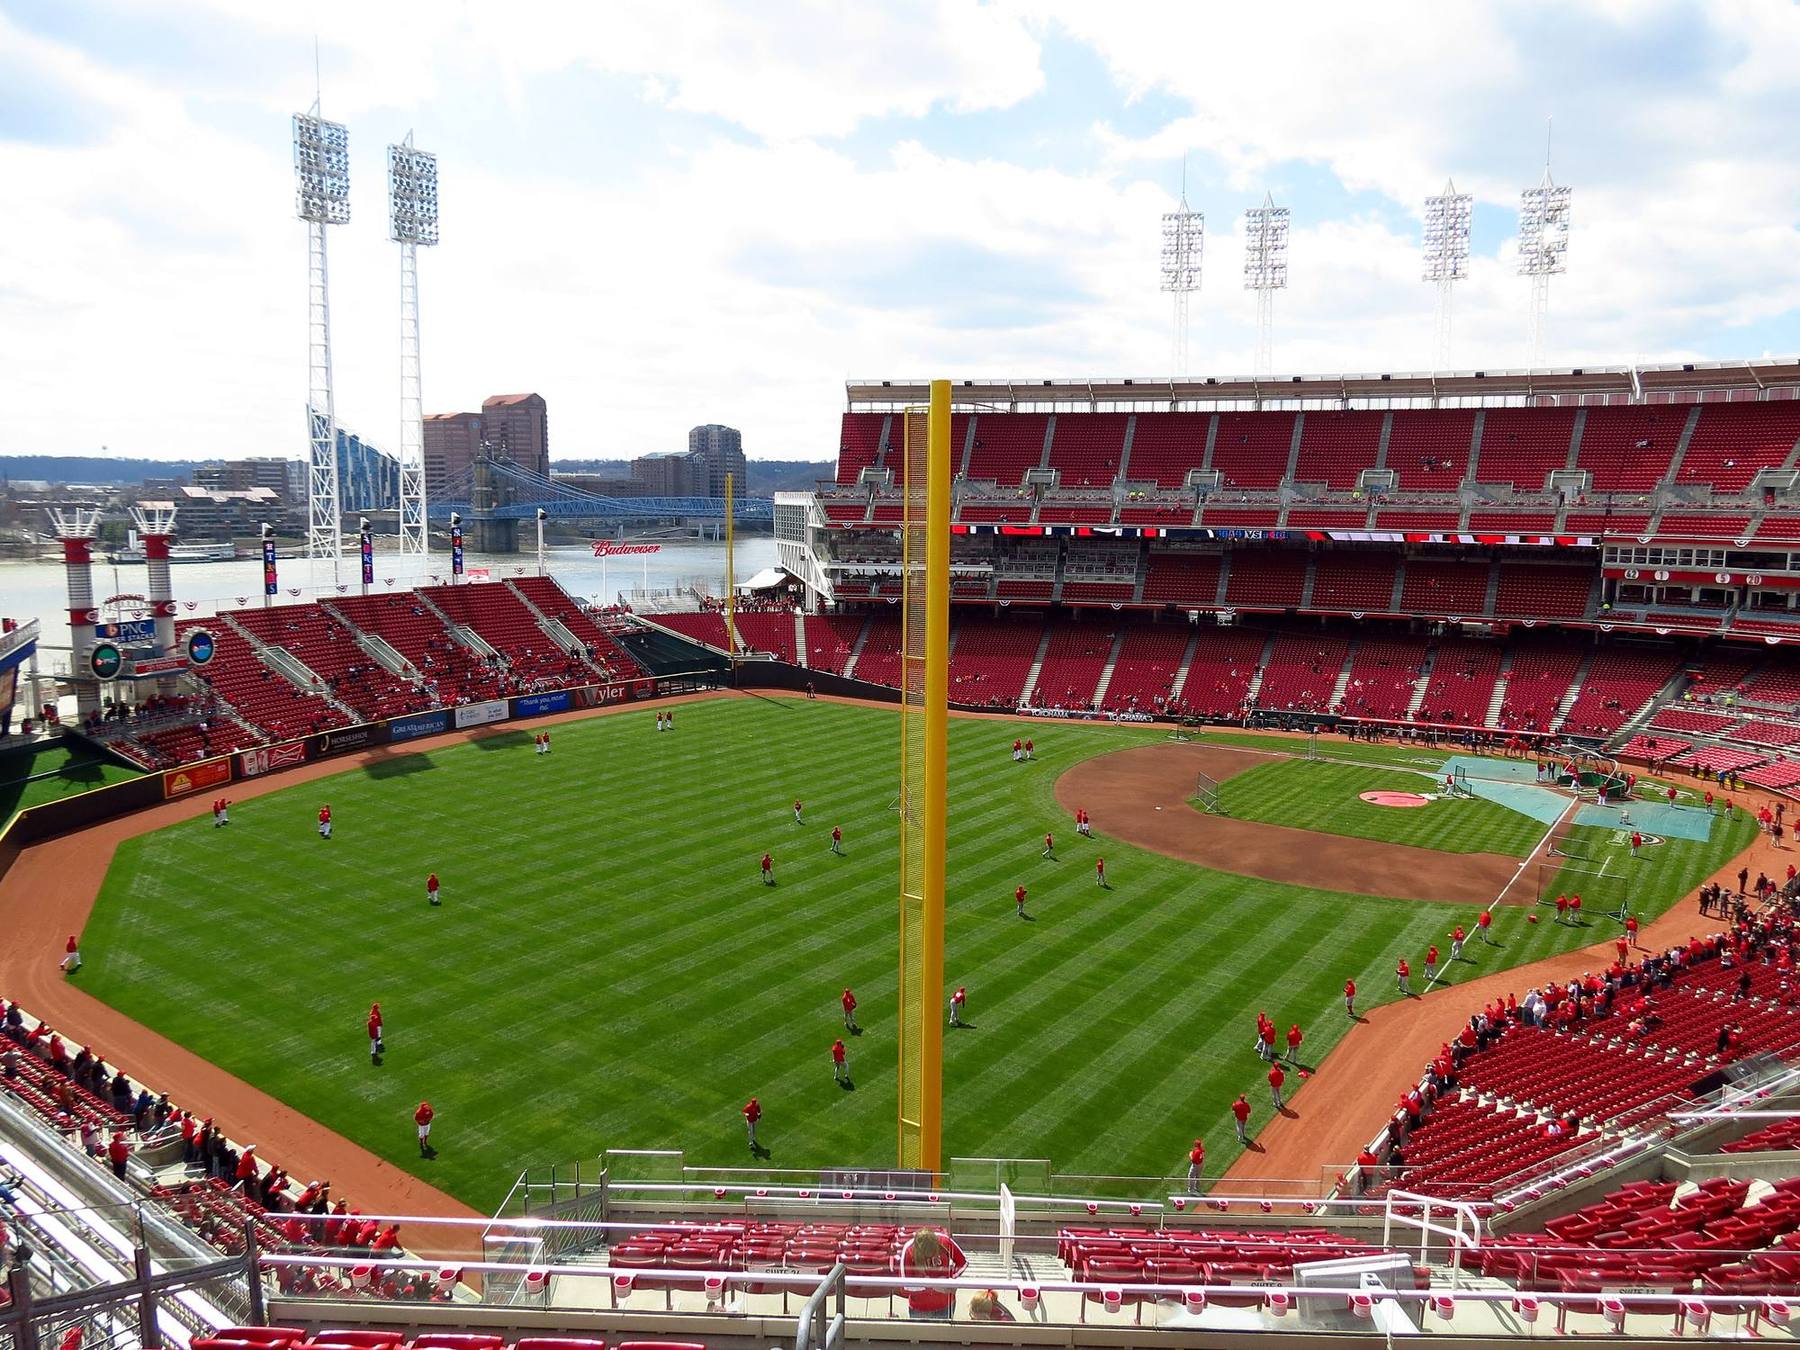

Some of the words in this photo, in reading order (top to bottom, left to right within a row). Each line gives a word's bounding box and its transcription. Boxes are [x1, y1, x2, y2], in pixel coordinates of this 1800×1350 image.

[592, 541, 660, 557] Budweiser
[1748, 575, 1760, 584] 20
[120, 622, 147, 635] PNC
[576, 686, 625, 706] Wyler
[1108, 711, 1147, 721] YOOHAMA
